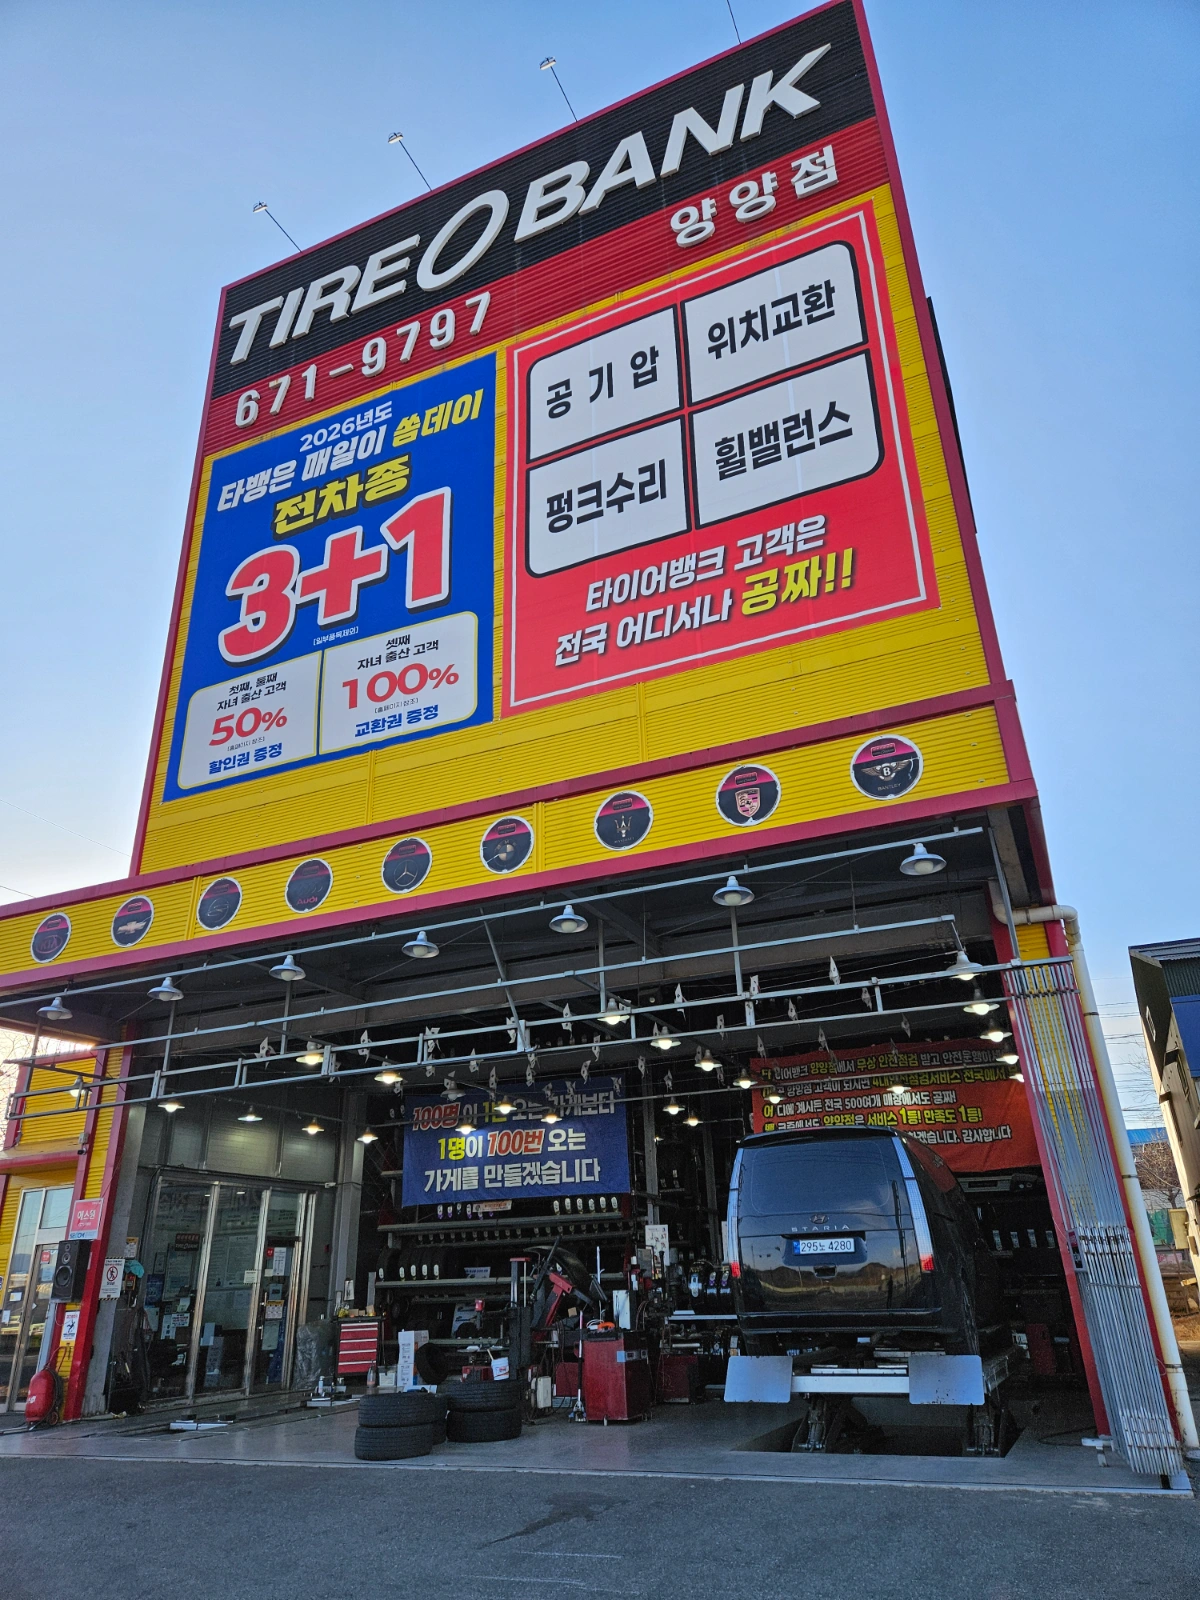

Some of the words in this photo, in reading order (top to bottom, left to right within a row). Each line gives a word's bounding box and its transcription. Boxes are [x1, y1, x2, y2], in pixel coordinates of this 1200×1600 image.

[670, 144, 839, 248] 양양점
[707, 279, 836, 360] 위치교환
[234, 291, 491, 428] 671-9797
[299, 401, 393, 452] 2026년도
[714, 401, 853, 481] 휠밸런스
[216, 459, 297, 512] 타뱅은
[301, 425, 388, 481] 매일이
[273, 453, 410, 536] 전차종
[546, 459, 667, 533] 펑크수리
[218, 486, 452, 664] 3+1
[585, 546, 725, 613] 타이어뱅크
[734, 514, 827, 572] 고객은
[555, 623, 608, 667] 전국
[616, 588, 733, 649] 어디서나
[740, 548, 854, 616] 공짜!!
[357, 654, 382, 670] 자녀
[385, 647, 410, 663] 출산
[413, 639, 439, 656] 고객
[385, 634, 411, 650] 셋째
[217, 696, 238, 711] 자녀
[241, 689, 262, 703] 출산
[264, 681, 287, 696] 고객
[256, 672, 278, 687] 둘째
[342, 663, 459, 710] 100%
[209, 707, 288, 746] 50%
[355, 713, 403, 737] 교환권
[406, 704, 439, 725] 증정
[209, 752, 250, 775] 할인권
[254, 742, 282, 762] 증정
[920, 1053, 941, 1066] 받고
[824, 1099, 843, 1111] 전국
[867, 1111, 898, 1126] 서비스
[899, 1107, 922, 1125] 1등!
[923, 1109, 957, 1124] 만족도
[958, 1105, 983, 1123] 1등!
[437, 1135, 483, 1161] 1명이
[487, 1128, 545, 1157] 100번
[547, 1128, 586, 1151] 오는
[908, 1130, 960, 1144] 겠습니다.
[962, 1125, 1012, 1142] 감사합니다
[424, 1166, 479, 1192] 가게를
[484, 1157, 601, 1188] 만들겠습니다
[791, 1224, 850, 1232] STARIA
[801, 1241, 826, 1252] 295노
[828, 1240, 852, 1251] 4280
